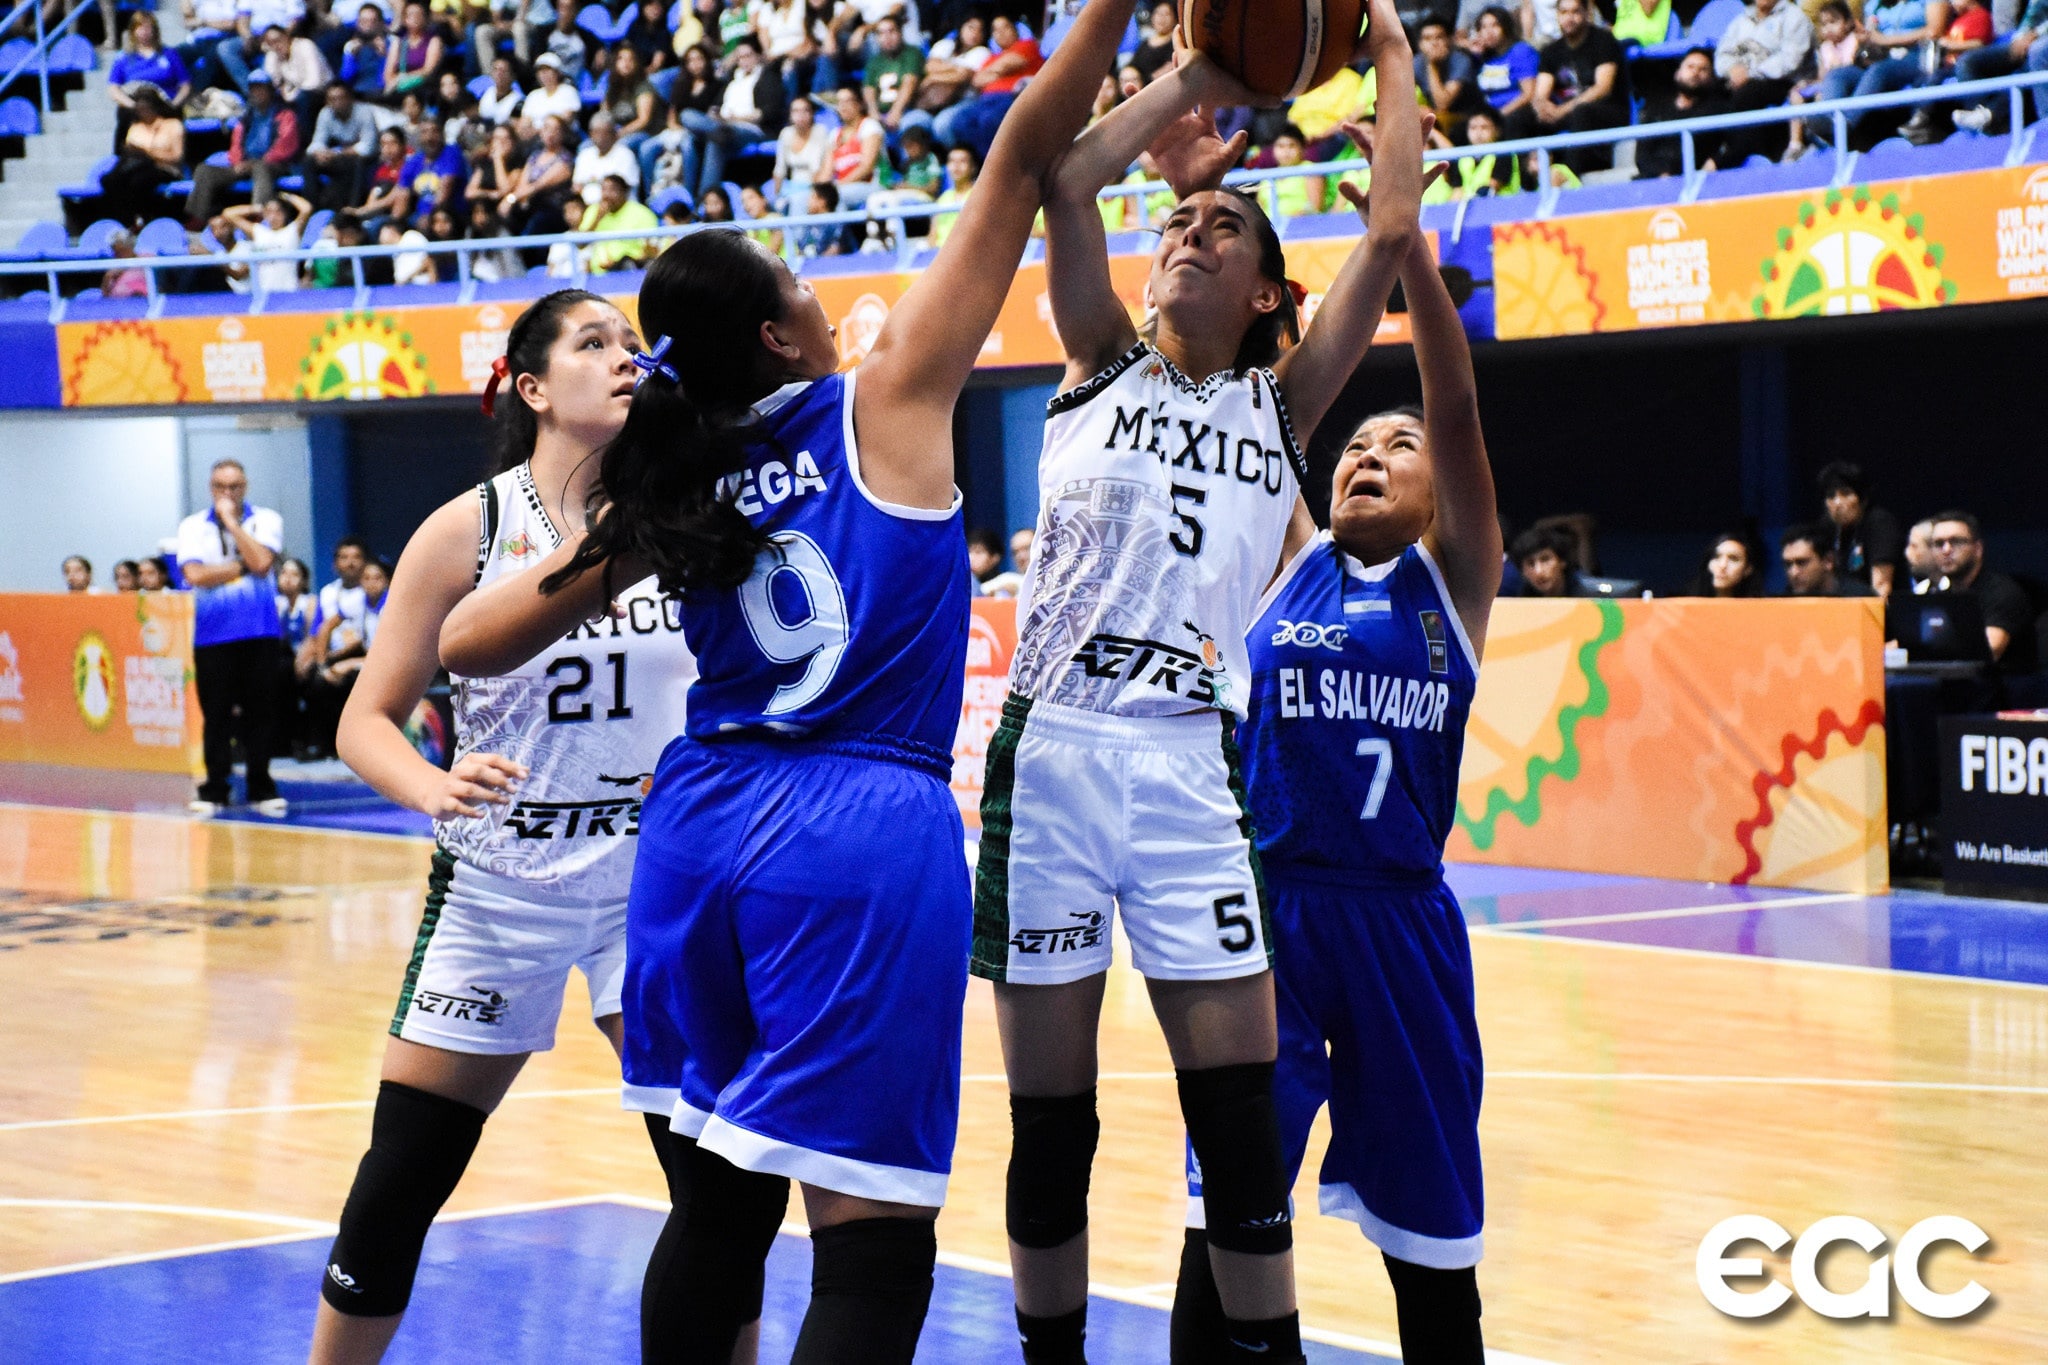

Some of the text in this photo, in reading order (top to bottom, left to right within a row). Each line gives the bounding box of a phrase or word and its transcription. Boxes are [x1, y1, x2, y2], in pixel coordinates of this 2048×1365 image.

[1104, 401, 1282, 497] MÉXICO
[1168, 483, 1208, 559] 5
[738, 529, 849, 716] 9
[546, 651, 633, 724] 21
[1279, 667, 1450, 733] EL SALVADOR
[1355, 737, 1393, 820] 7
[1960, 734, 2048, 796] FIBA
[1955, 840, 1977, 861] We
[1979, 841, 2002, 863] Are
[1213, 892, 1256, 953] 5
